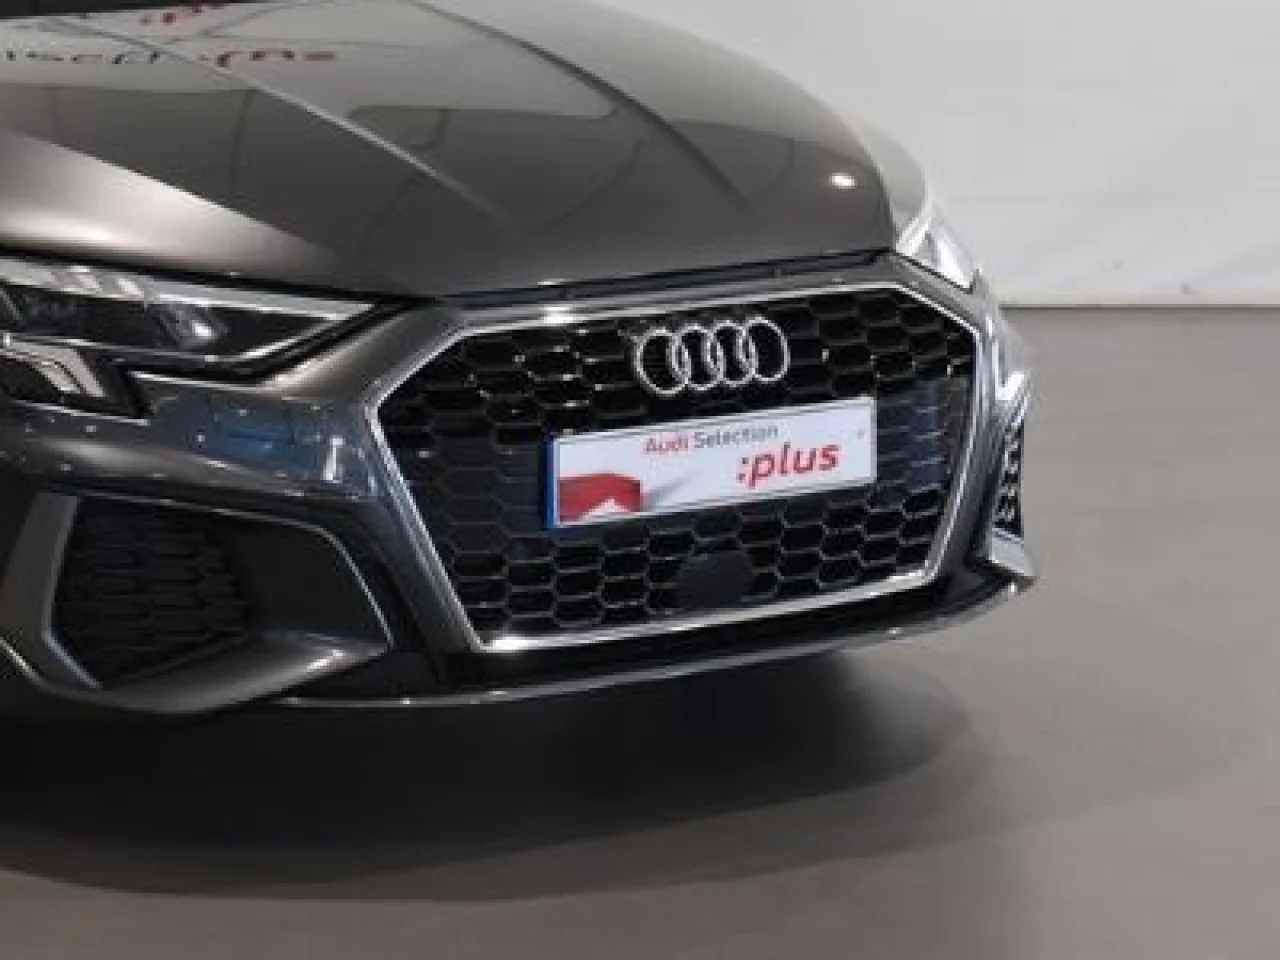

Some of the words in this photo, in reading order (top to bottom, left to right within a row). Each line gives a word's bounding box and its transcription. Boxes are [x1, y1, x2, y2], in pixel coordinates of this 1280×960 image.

[644, 434, 690, 453] Audi
[693, 425, 778, 448] Selection
[737, 442, 839, 488] :plus
